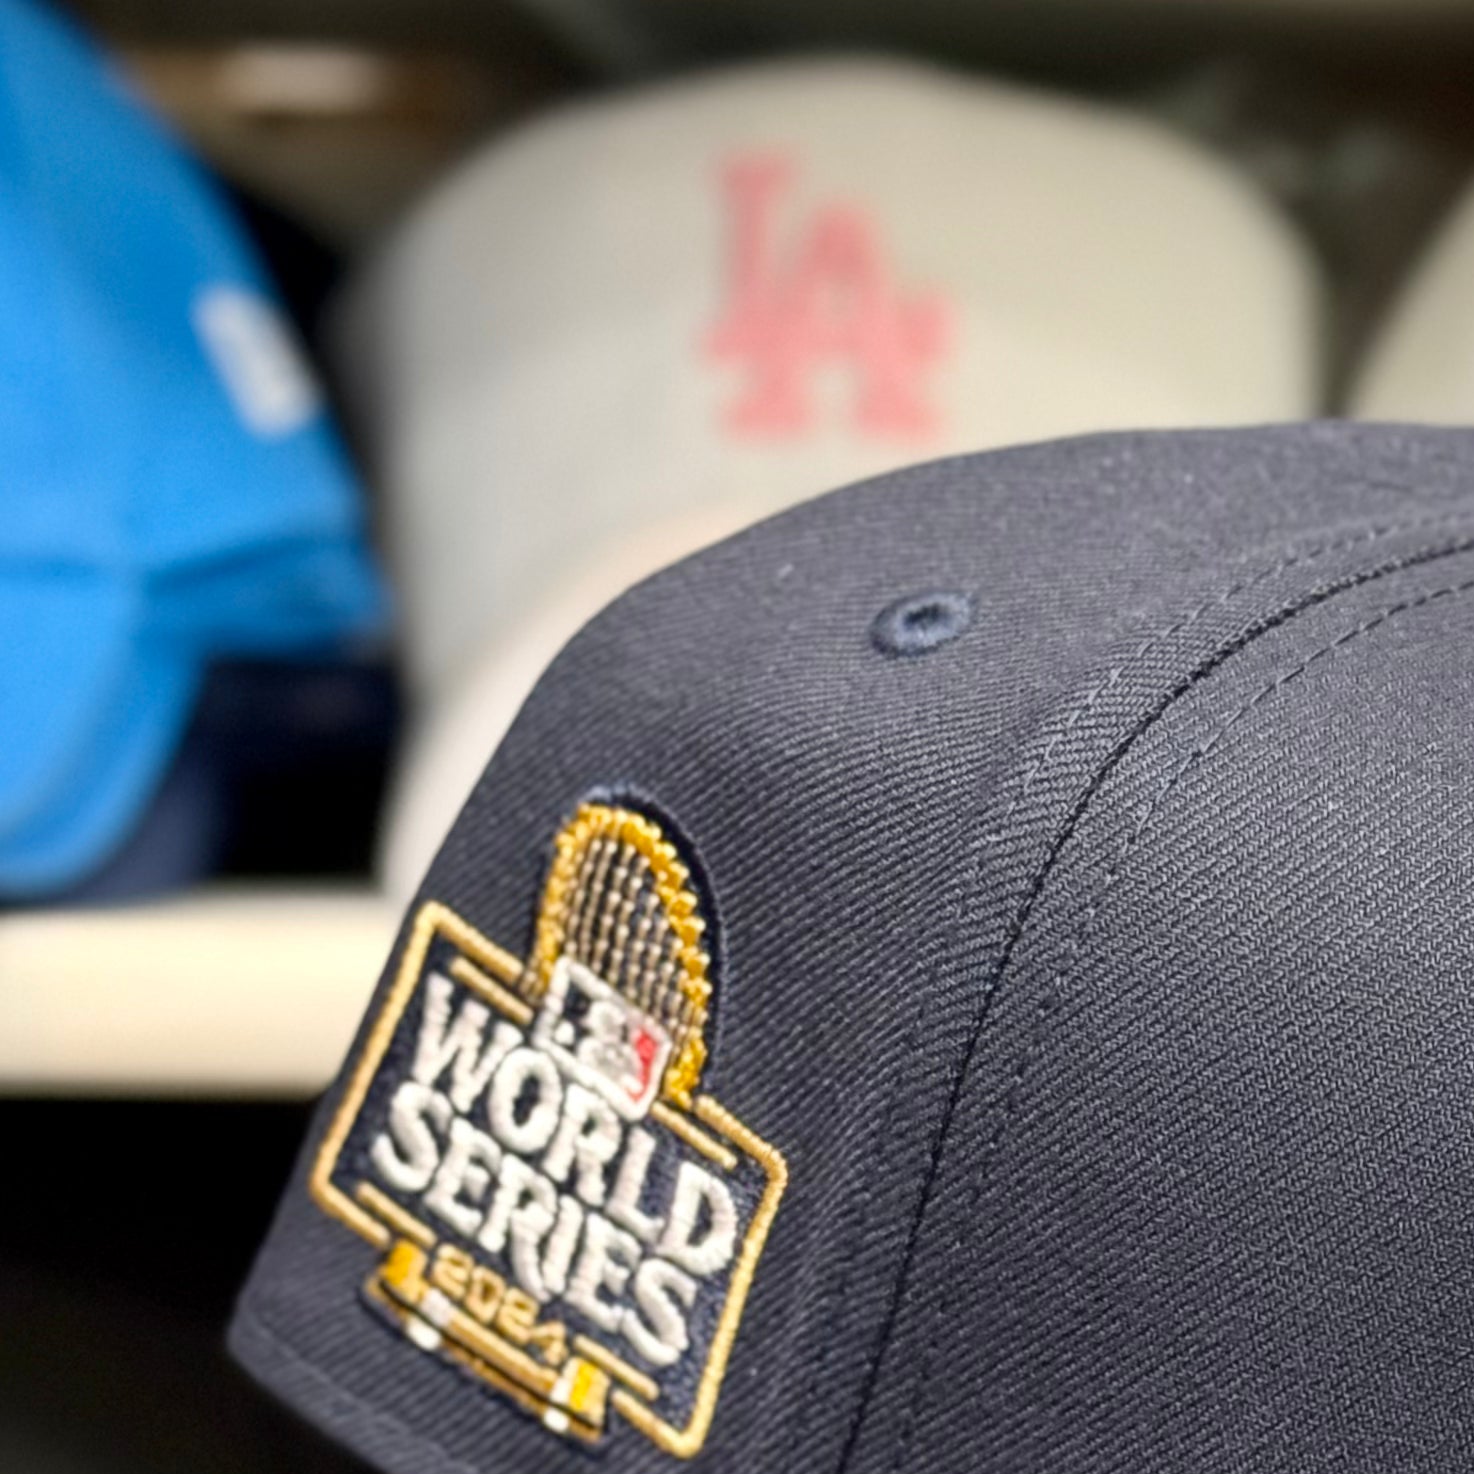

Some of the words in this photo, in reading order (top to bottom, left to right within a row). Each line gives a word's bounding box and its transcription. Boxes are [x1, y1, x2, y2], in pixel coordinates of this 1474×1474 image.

[700, 148, 952, 440] LA
[371, 1082, 698, 1367] SERIES
[413, 973, 736, 1275] WORLD
[433, 1243, 569, 1366] 2024
